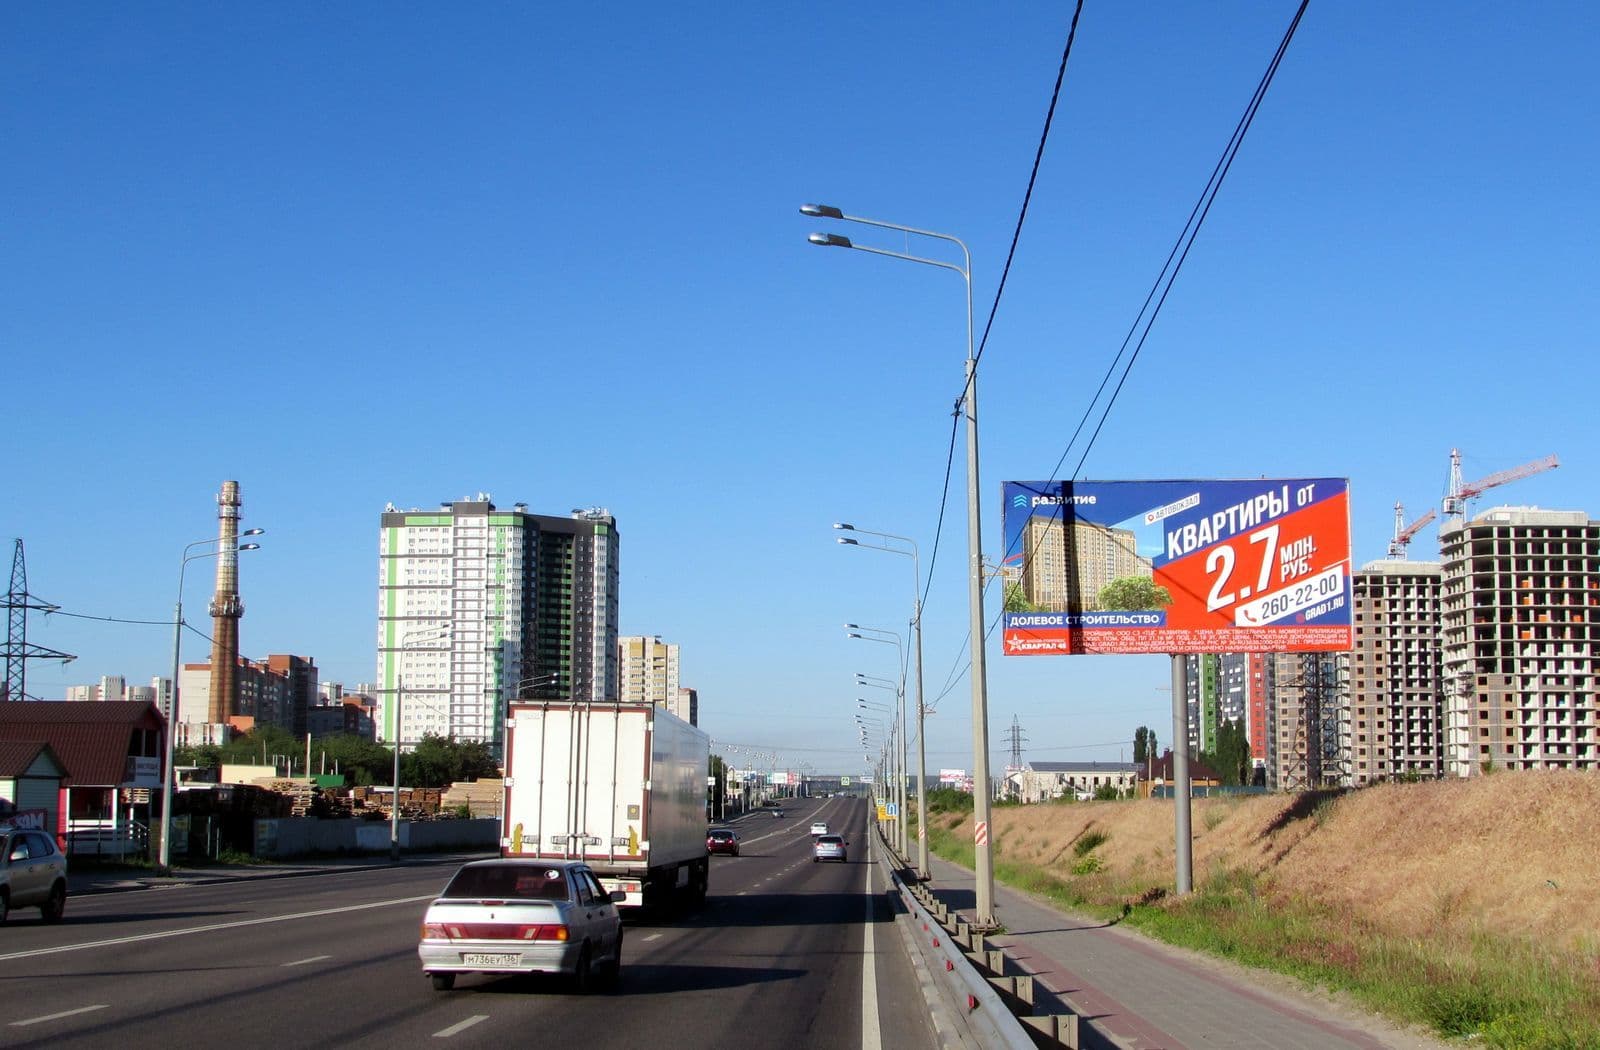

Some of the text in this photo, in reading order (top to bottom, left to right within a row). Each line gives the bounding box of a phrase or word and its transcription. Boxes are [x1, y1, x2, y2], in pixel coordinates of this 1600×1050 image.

[1031, 495, 1096, 507] развитие
[1155, 495, 1198, 519] АВТОВОКЗАЛ
[1168, 485, 1289, 560] КВАРТИРЫ
[1280, 535, 1317, 565] МЛН.
[1205, 524, 1281, 613] 2.7
[1261, 574, 1338, 620] 260-22-00
[1304, 596, 1344, 621] GRAD1.RU
[1010, 614, 1160, 627] ДОЛЕВОЕ СТРОИТЕЛЬСТВО
[1021, 642, 1057, 650] КВАРТАЛ
